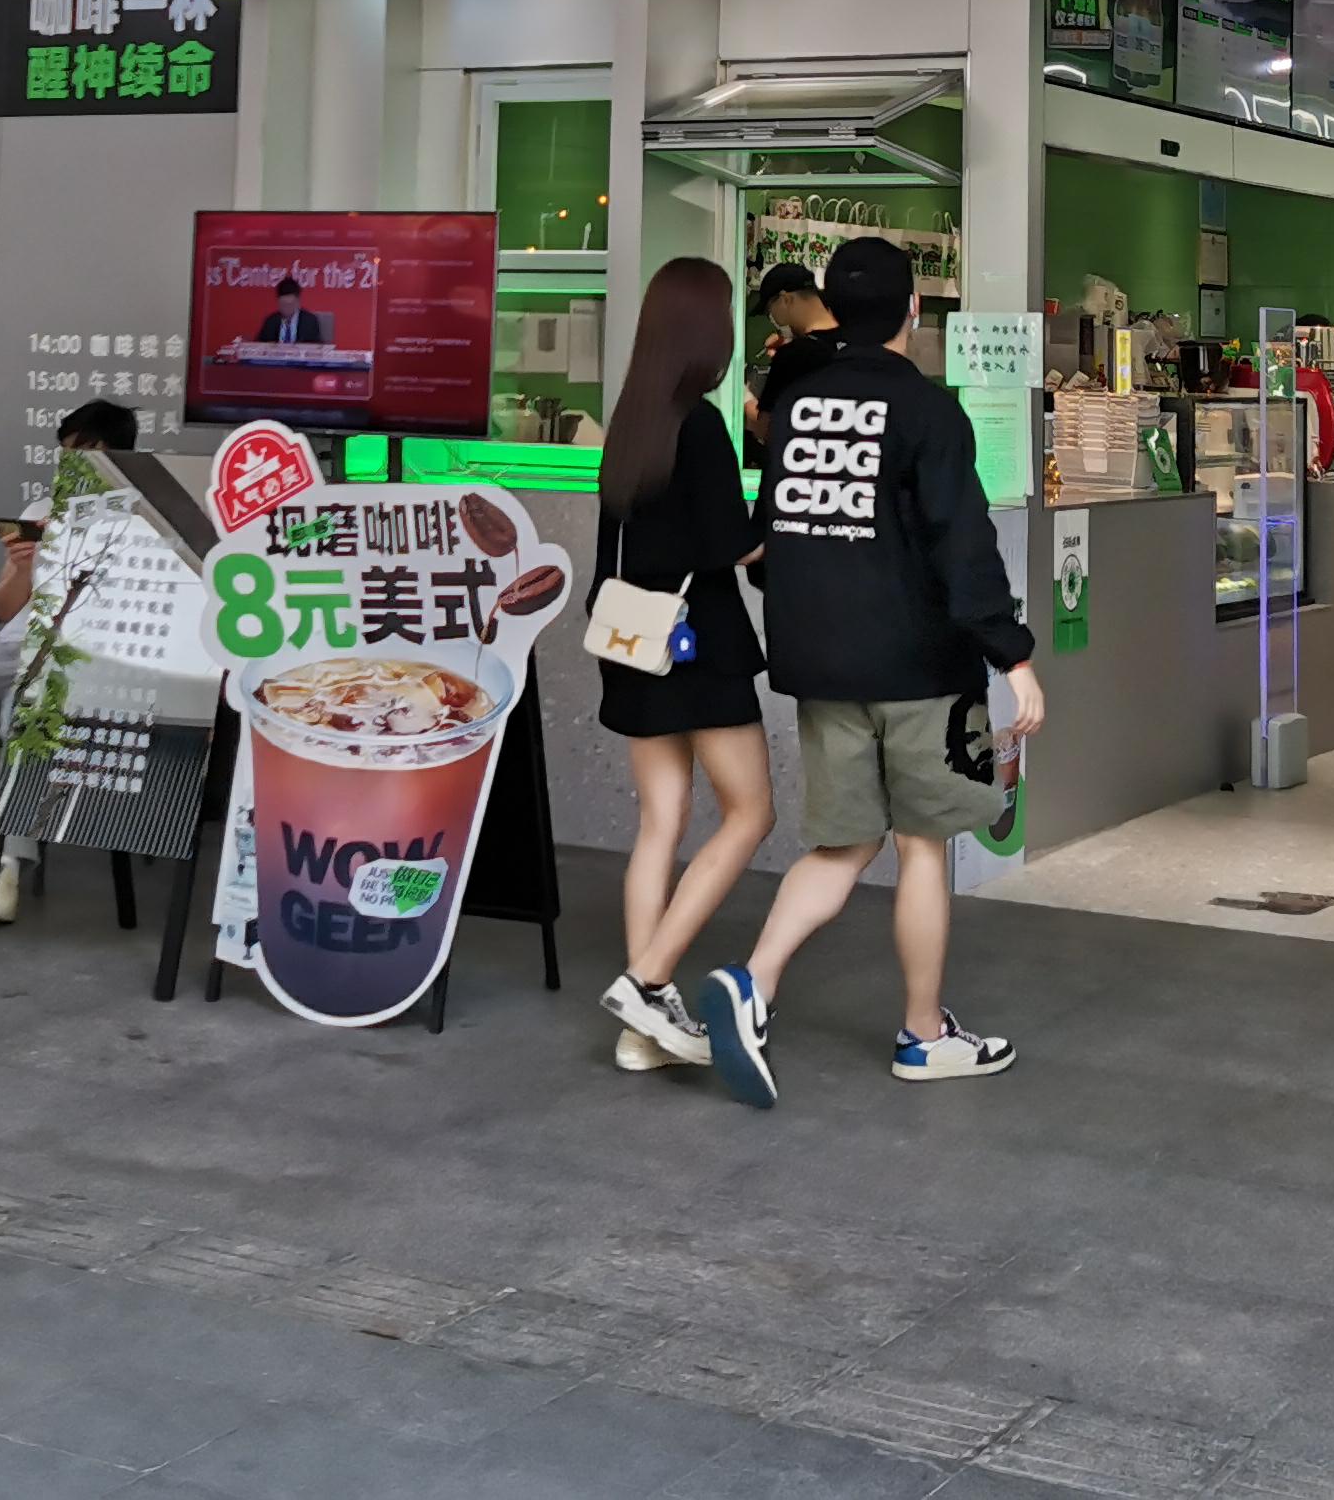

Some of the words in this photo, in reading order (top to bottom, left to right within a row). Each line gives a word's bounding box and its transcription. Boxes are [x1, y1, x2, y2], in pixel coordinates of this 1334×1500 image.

[25, 39, 216, 100] 醒神续命
[28, 333, 82, 355] 14:00
[27, 370, 80, 392] 15:00
[791, 396, 888, 436] CDG
[783, 437, 882, 478] CDG
[775, 477, 876, 519] CDG
[266, 501, 462, 558] 现磨咖啡
[213, 553, 499, 658] 8元美式
